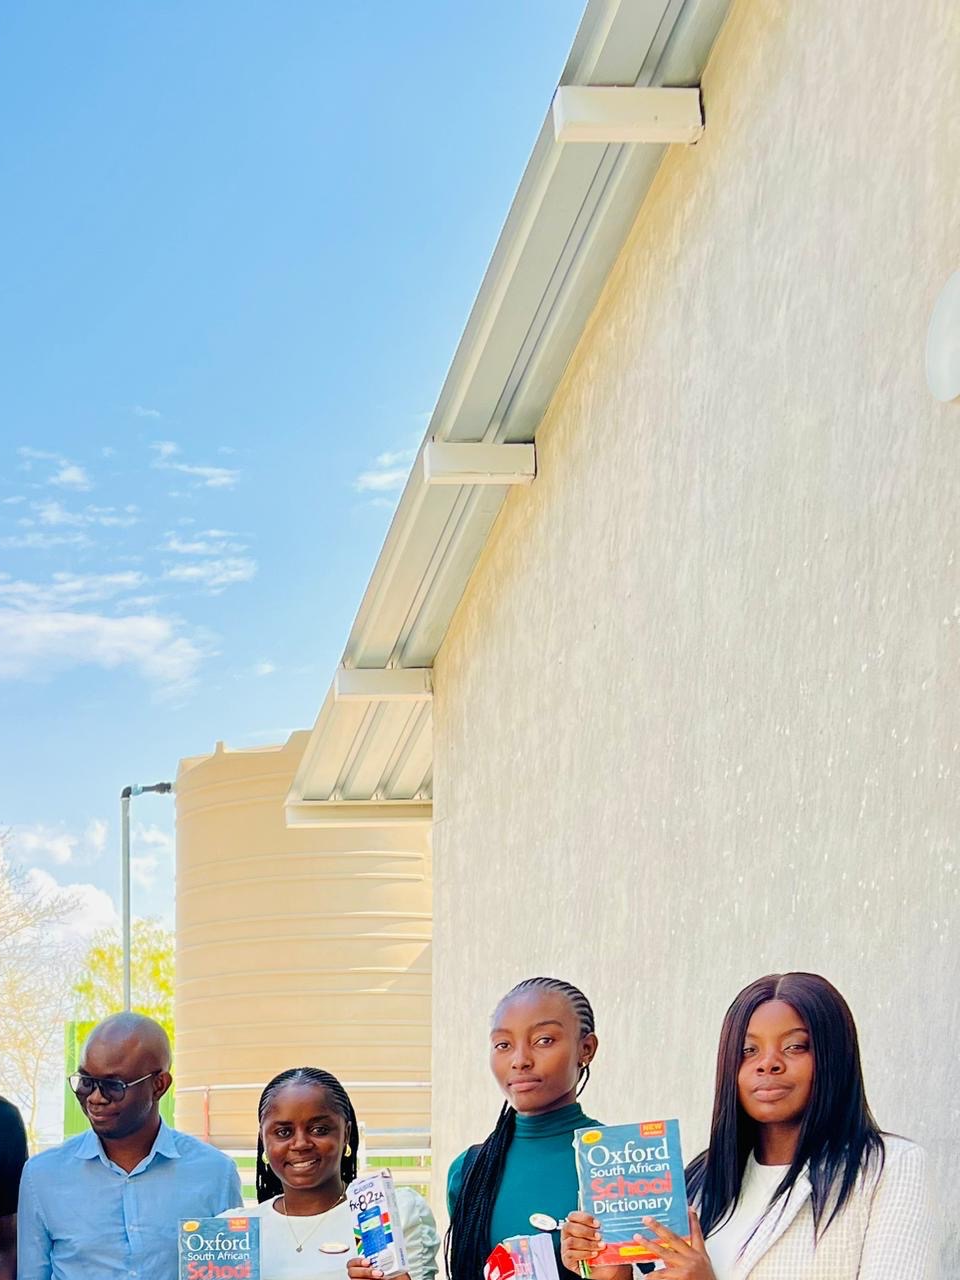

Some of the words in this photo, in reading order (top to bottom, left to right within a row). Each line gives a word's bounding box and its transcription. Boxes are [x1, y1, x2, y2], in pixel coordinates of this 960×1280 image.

[587, 1137, 670, 1167] Oxford
[590, 1165, 625, 1179] South
[628, 1162, 669, 1175] African
[591, 1171, 672, 1200] School
[593, 1197, 672, 1215] Dictionary
[187, 1232, 251, 1252] Oxford
[188, 1252, 215, 1261] South
[218, 1251, 250, 1260] African
[188, 1260, 251, 1280] School
